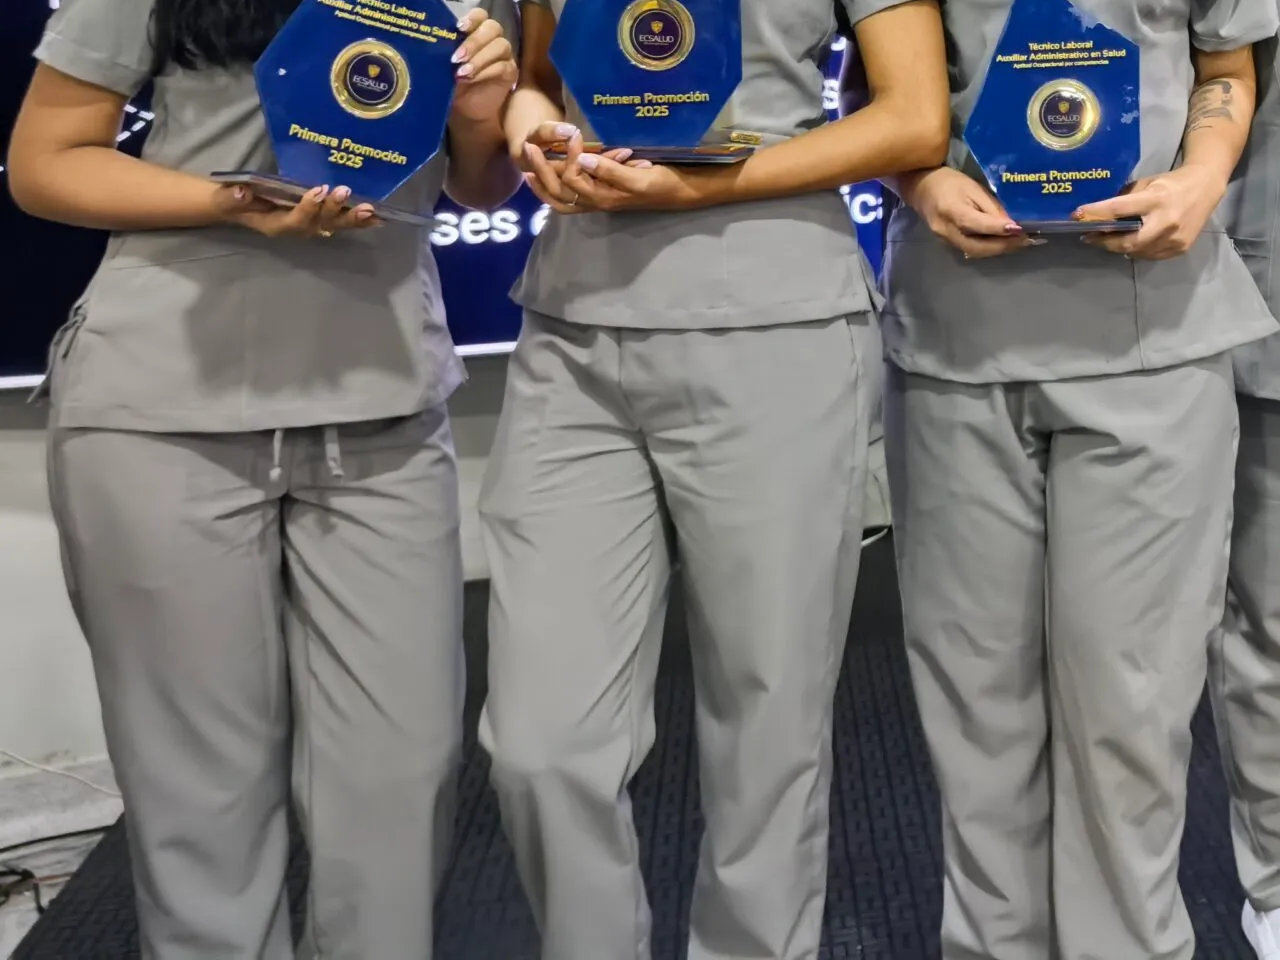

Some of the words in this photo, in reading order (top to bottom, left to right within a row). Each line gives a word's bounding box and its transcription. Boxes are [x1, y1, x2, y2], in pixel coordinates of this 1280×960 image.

[392, 2, 426, 21] Laboral
[354, 3, 418, 30] Administrativo
[419, 23, 431, 34] en
[432, 26, 457, 40] Salud
[639, 34, 674, 43] ECSALUD
[1028, 42, 1059, 51] Técnico
[1061, 40, 1093, 50] Laboral
[996, 53, 1028, 63] Auxiliar
[1029, 50, 1089, 61] Administrativo
[1102, 48, 1126, 58] Salud
[593, 94, 641, 105] Primera
[644, 91, 709, 104] Promoción
[635, 105, 669, 117] 2025
[289, 124, 338, 148] Primera
[341, 138, 407, 165] Promoción
[328, 150, 363, 169] 2025
[1002, 172, 1046, 183] Primera
[1049, 168, 1111, 181] Promoción
[1041, 183, 1073, 194] 2025
